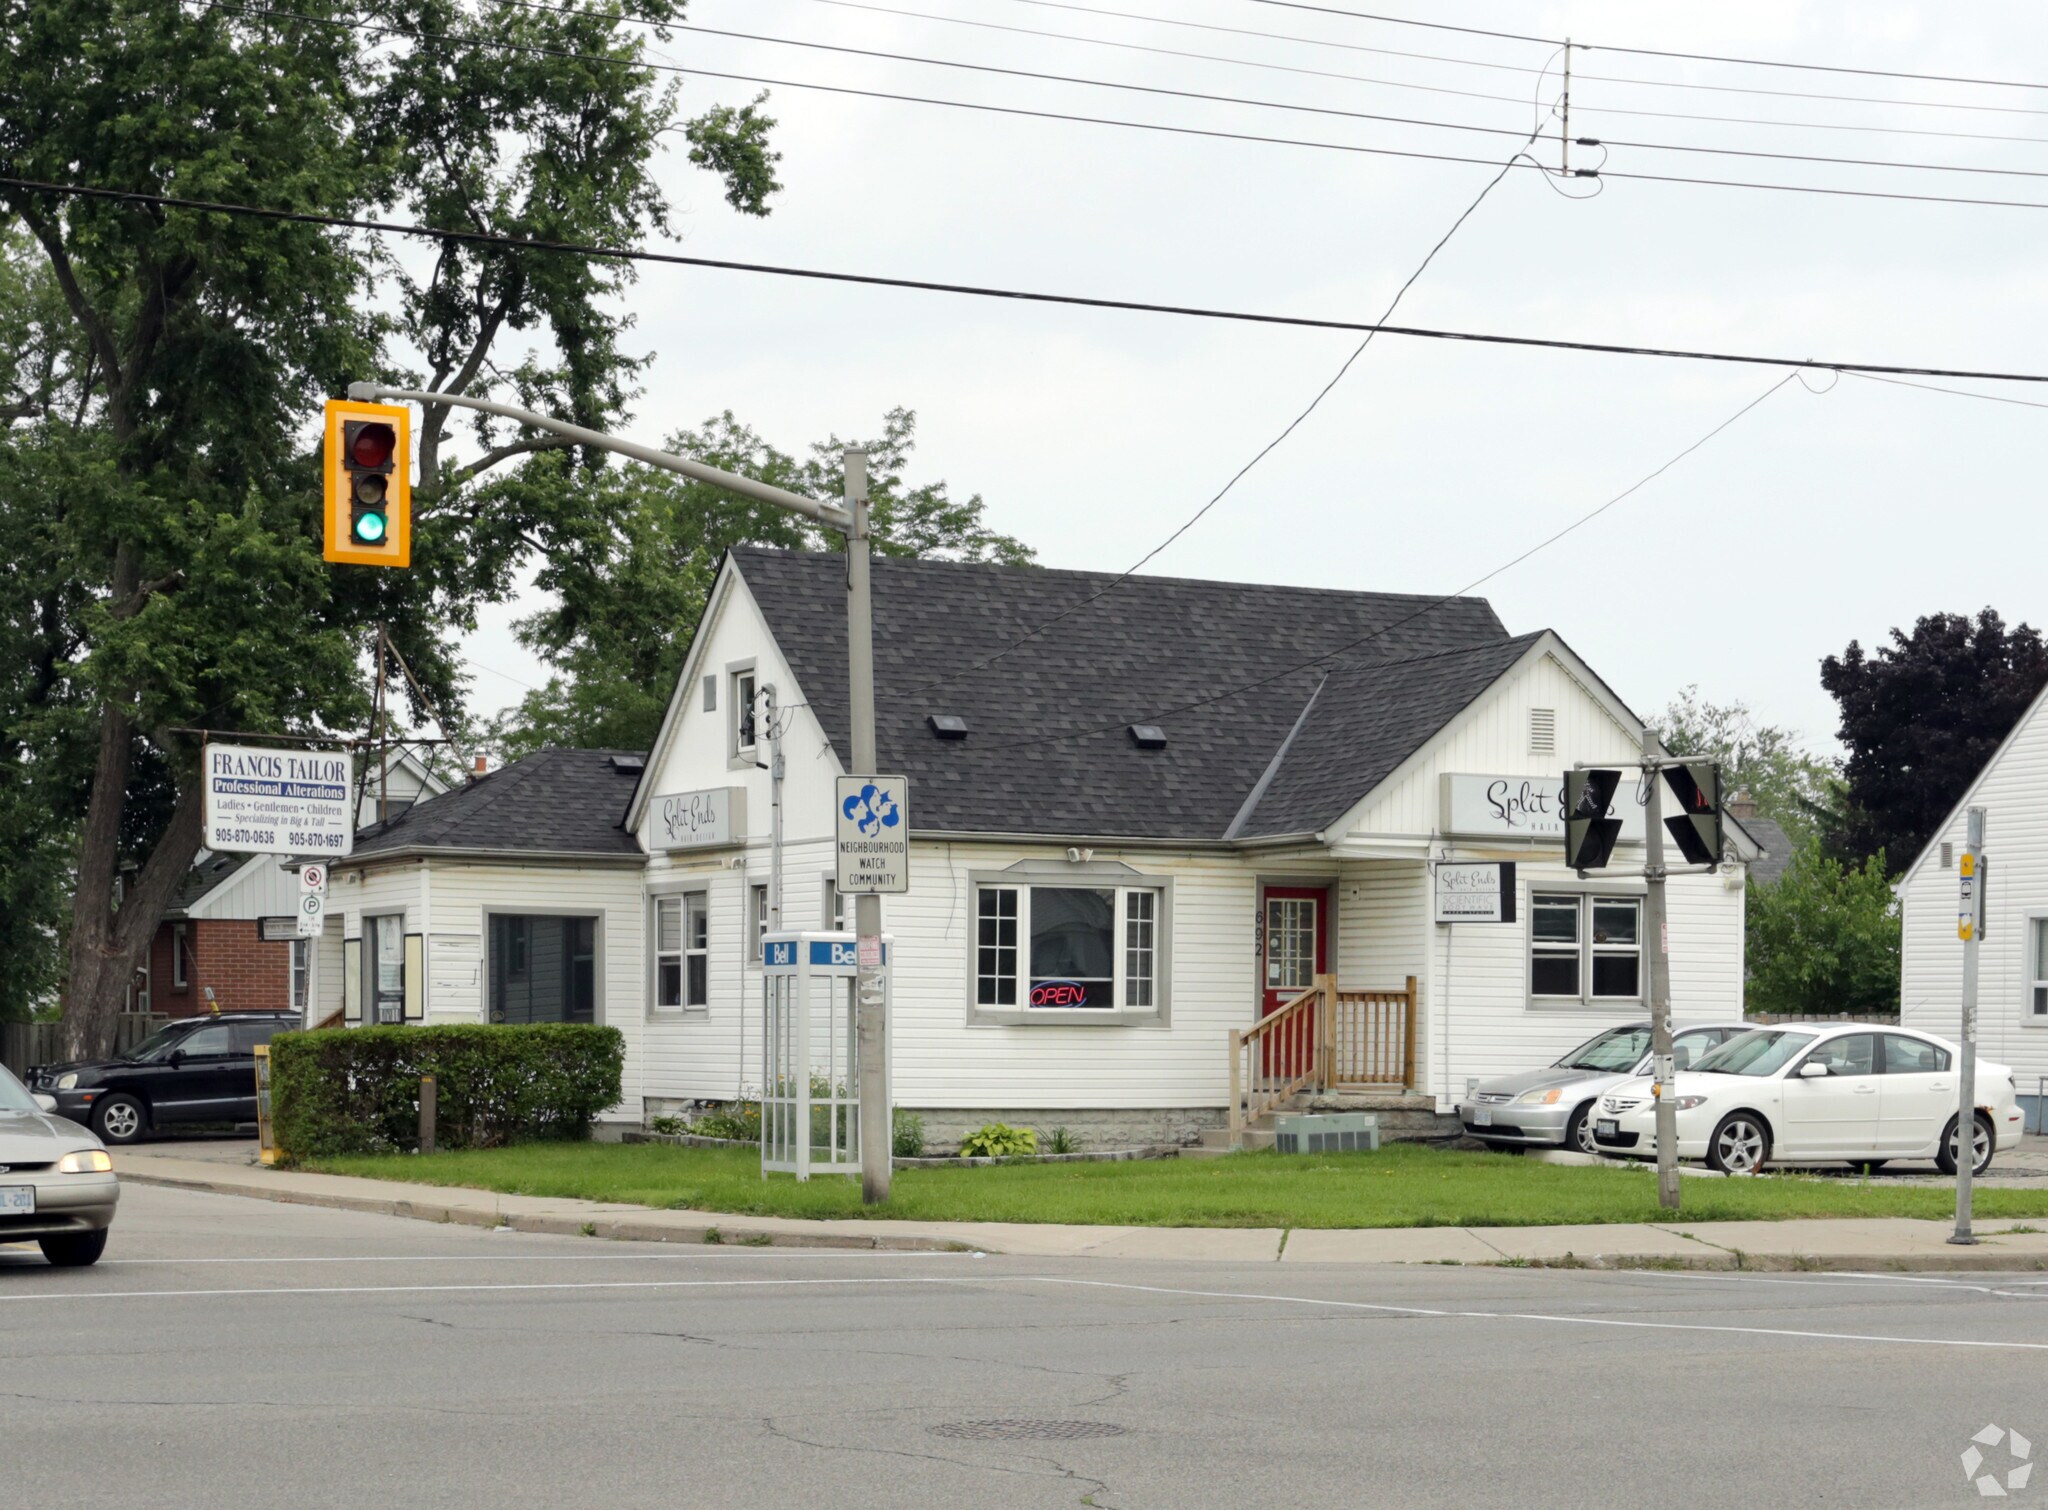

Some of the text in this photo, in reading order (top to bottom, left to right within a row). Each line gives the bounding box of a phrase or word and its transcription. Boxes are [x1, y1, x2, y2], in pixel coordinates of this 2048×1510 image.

[213, 753, 345, 782] FRANCIS TAILOR
[215, 780, 344, 800] Professional Alterations
[217, 799, 342, 816] Ladies Gentlemen Children
[1487, 780, 1553, 829] Split
[235, 813, 279, 826] Specializing
[280, 816, 288, 825] in
[289, 816, 302, 827] Big
[311, 817, 325, 827] Tall
[663, 794, 715, 840] Split Ends
[1531, 822, 1558, 832] HAIR
[216, 828, 343, 848] 905-870-0636 905-870-1697
[840, 841, 905, 854] NEIGHBOURHOOD
[859, 858, 886, 869] WATCH
[849, 873, 897, 886] COMMUNITY
[1442, 870, 1496, 889] Split Ends
[1442, 895, 1494, 905] SCIENTIFIC
[1255, 911, 1264, 956] 692
[774, 943, 789, 964] Bell
[1030, 986, 1084, 1005] OPEN
